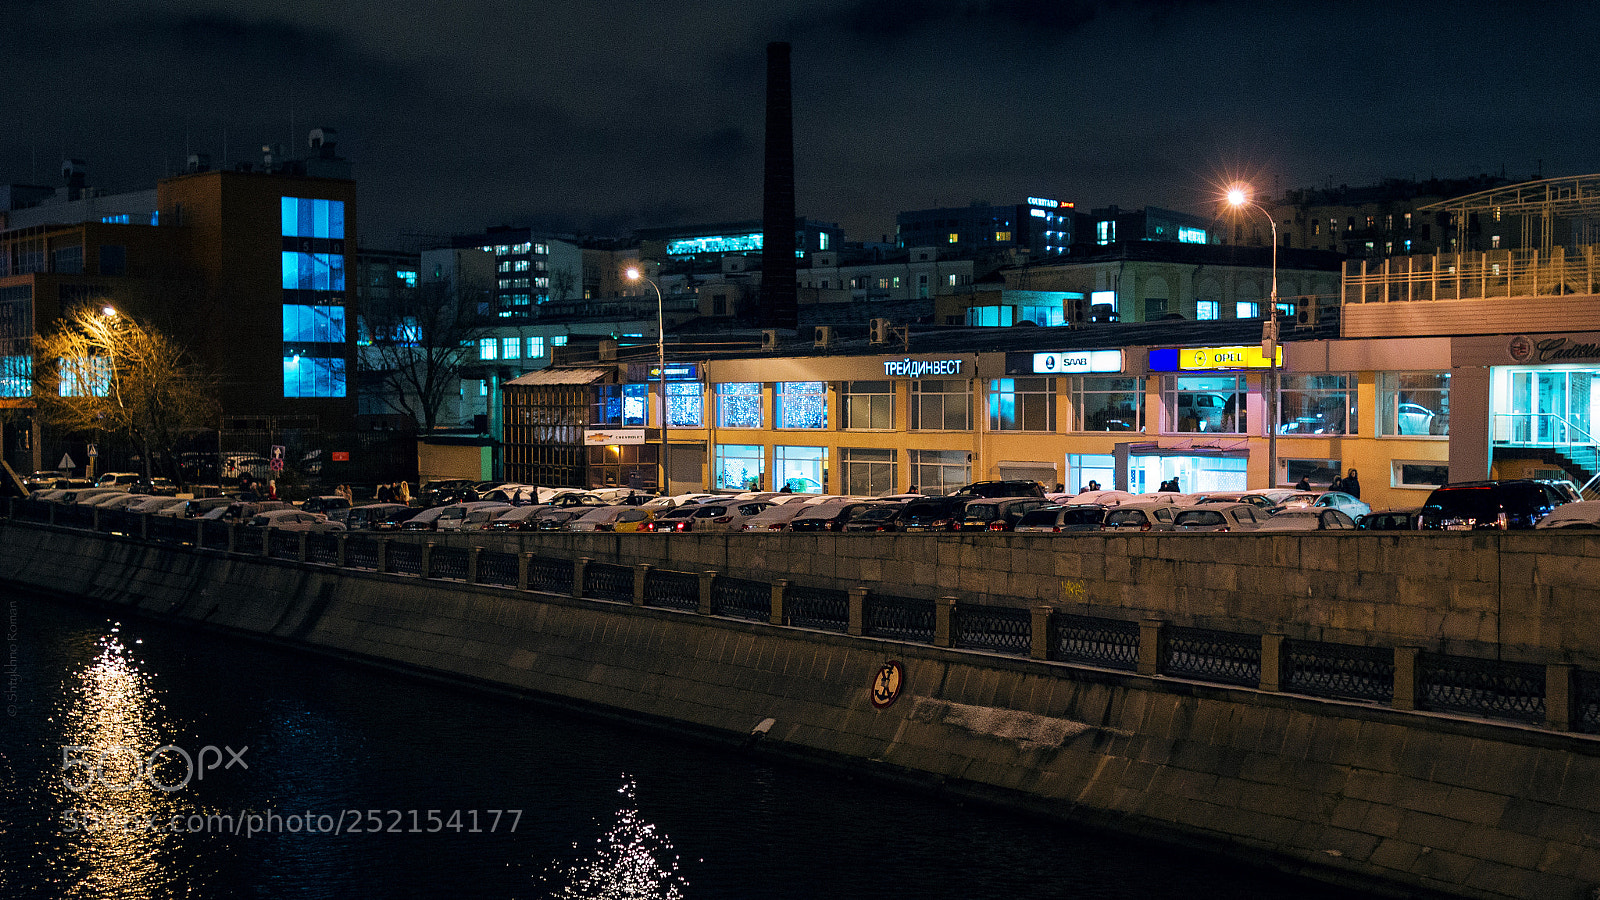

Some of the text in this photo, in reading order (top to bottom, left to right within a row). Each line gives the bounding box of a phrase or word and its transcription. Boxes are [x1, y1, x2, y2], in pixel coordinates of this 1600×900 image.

[1063, 357, 1087, 367] SAAB
[1214, 352, 1243, 363] OPEL
[883, 357, 962, 378] ТРЕЙДИНВЕСТ
